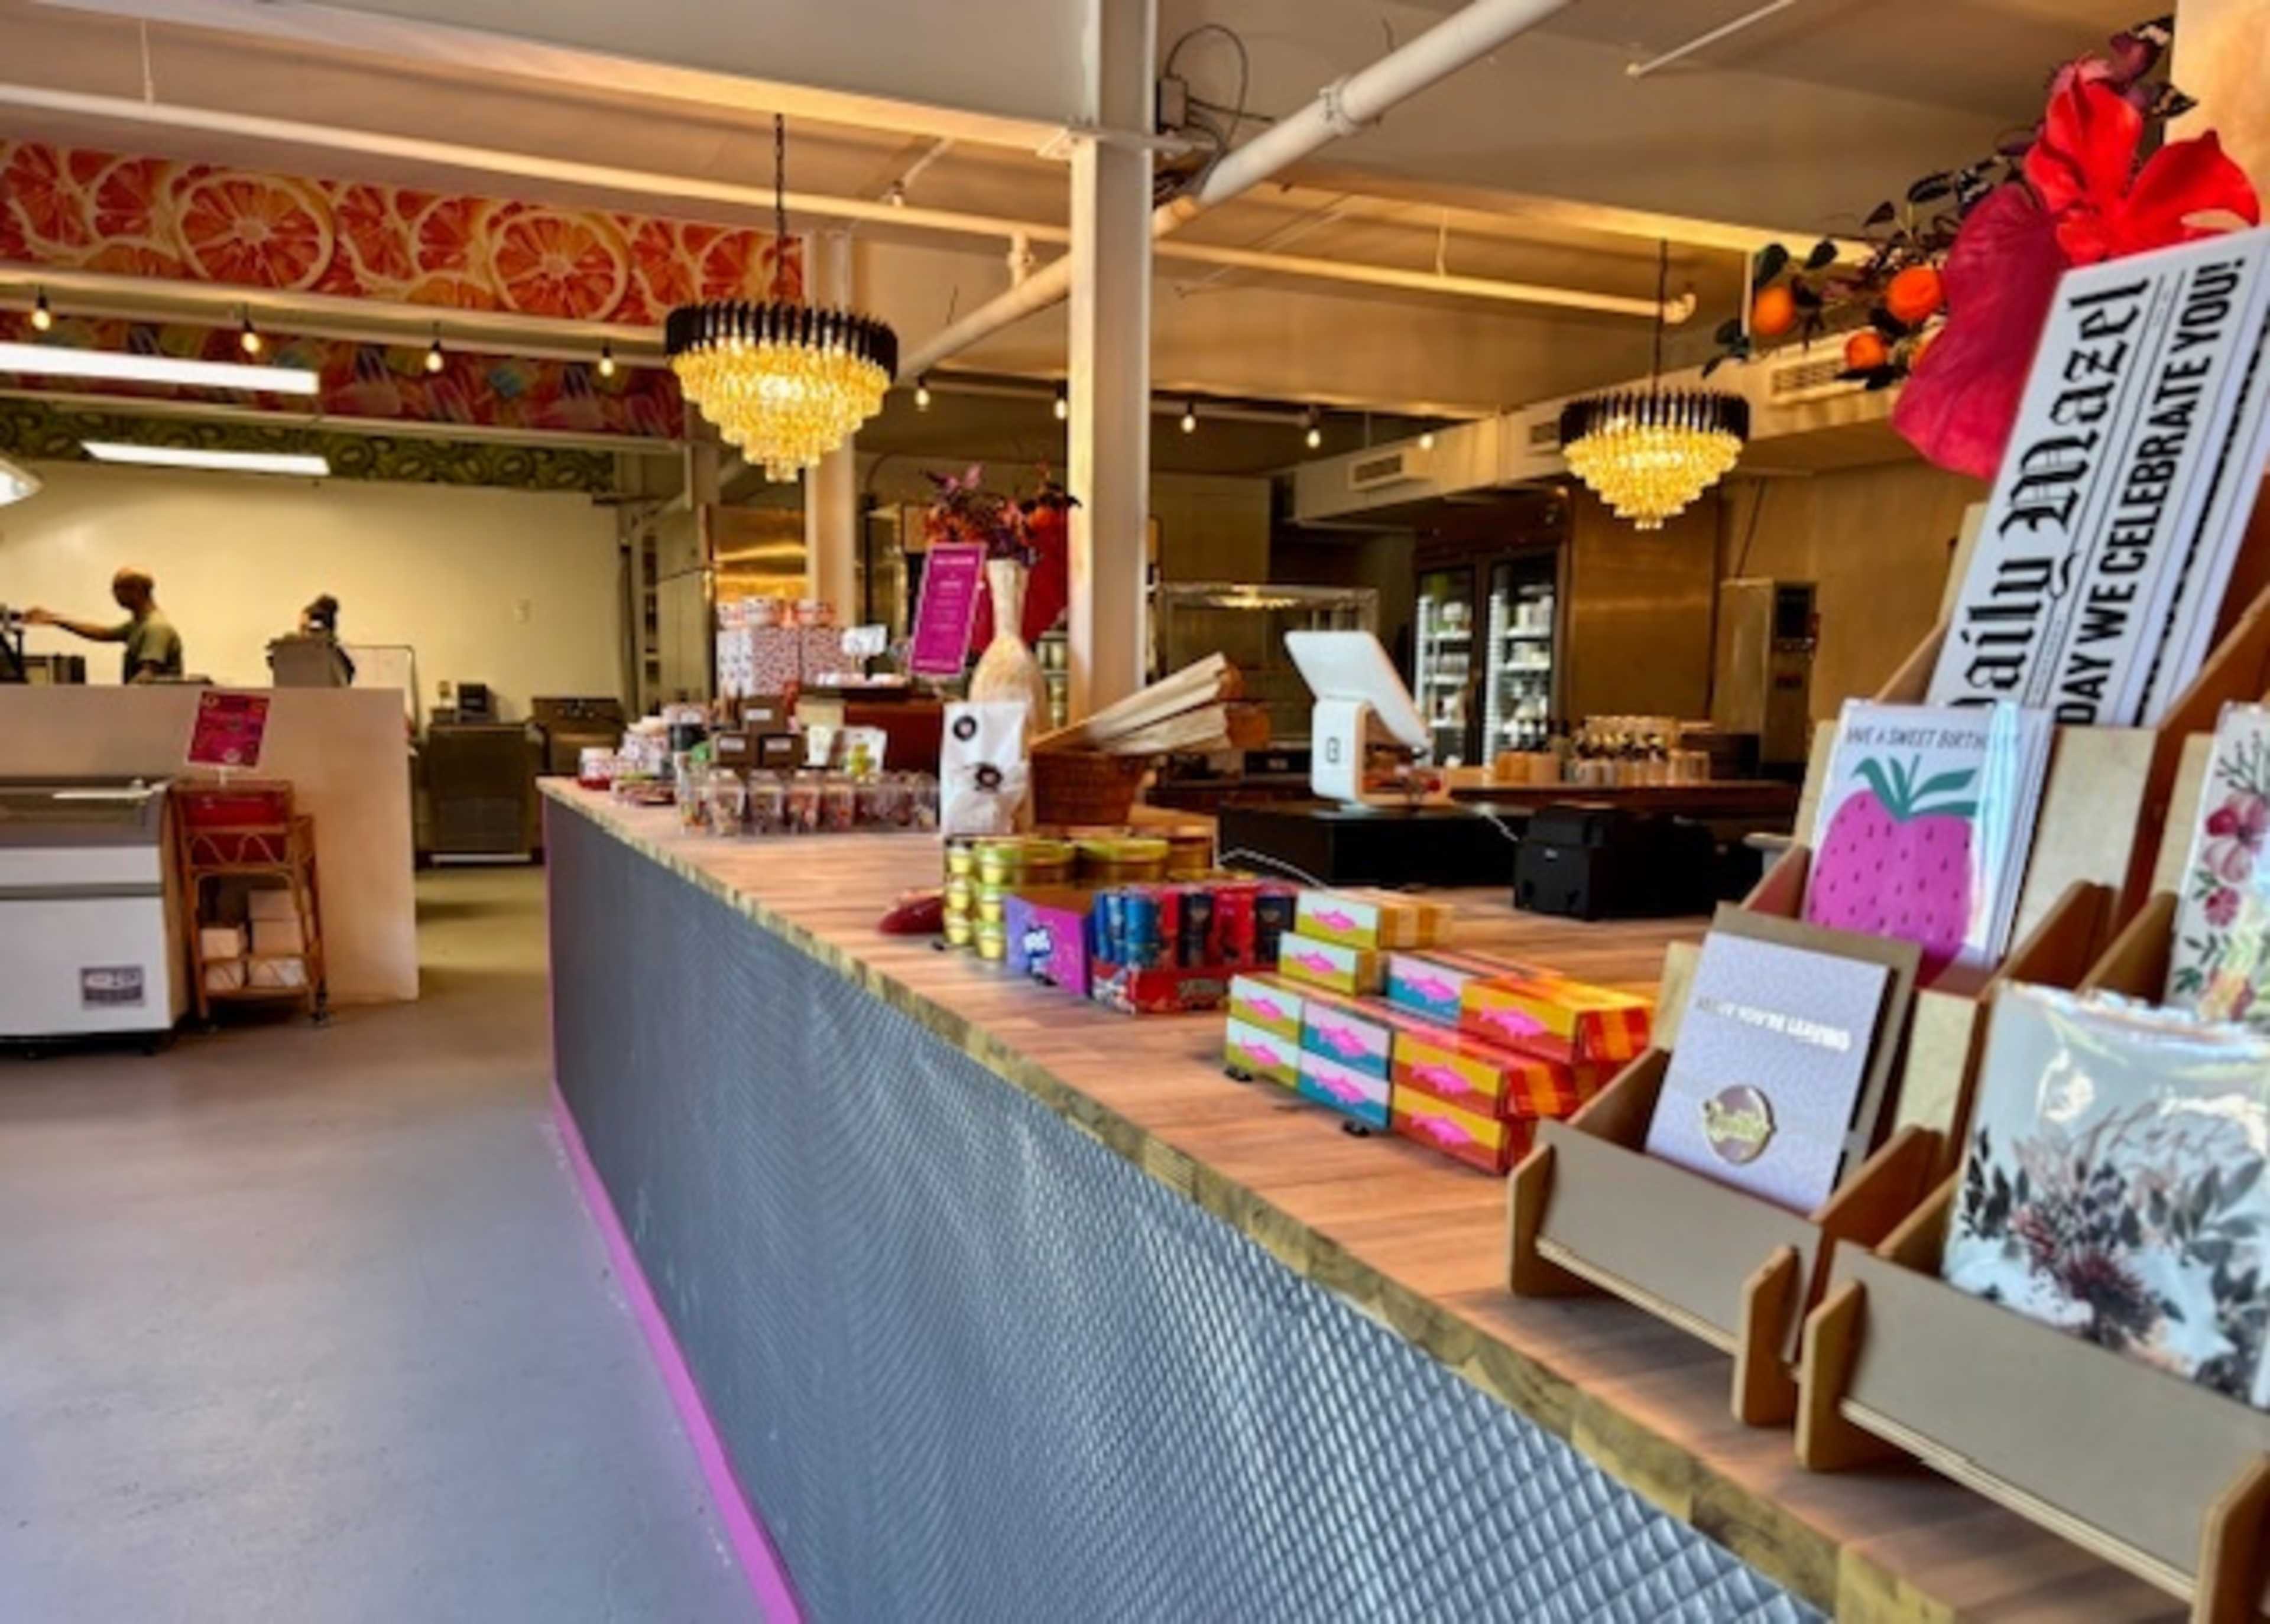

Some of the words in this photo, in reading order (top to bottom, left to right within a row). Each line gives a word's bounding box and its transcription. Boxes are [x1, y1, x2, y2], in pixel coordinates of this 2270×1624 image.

[2168, 256, 2248, 356] YOU!
[1998, 276, 2150, 542] Mazel
[2098, 355, 2213, 581] CELEBRATE
[2074, 582, 2135, 646] WE
